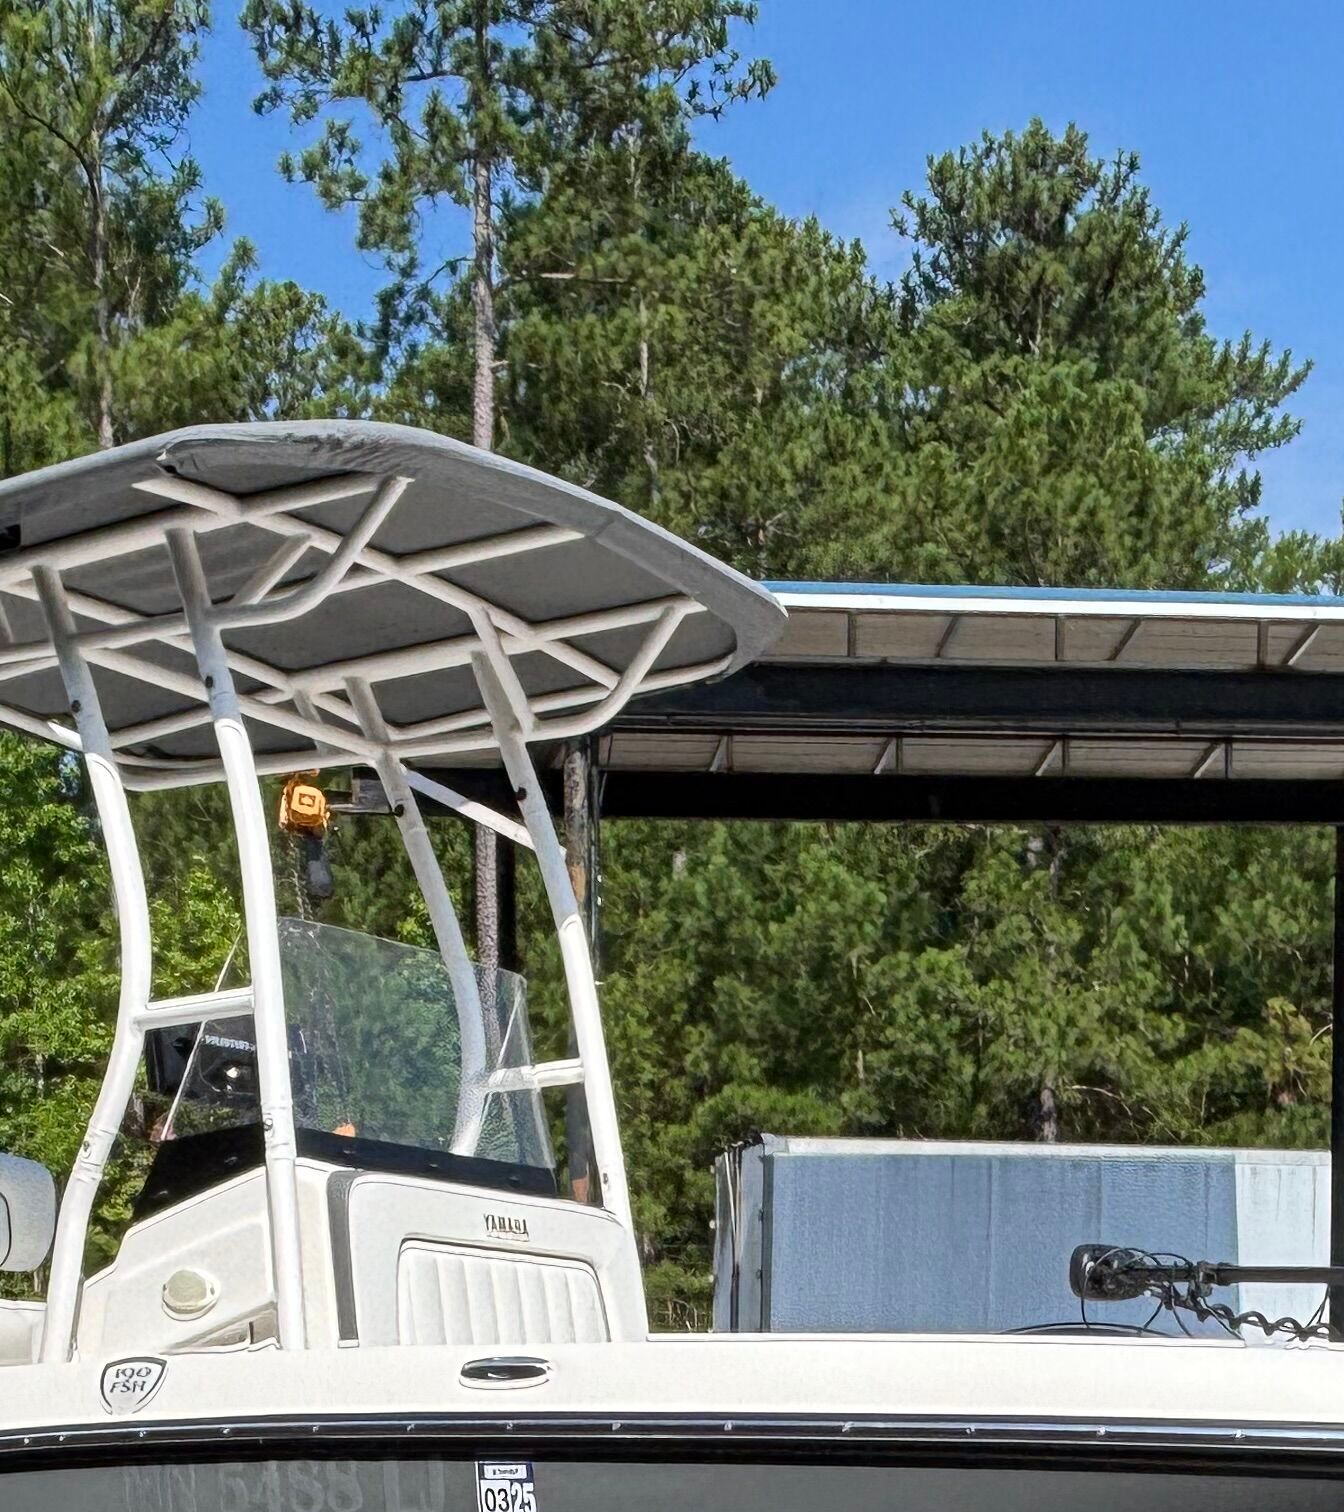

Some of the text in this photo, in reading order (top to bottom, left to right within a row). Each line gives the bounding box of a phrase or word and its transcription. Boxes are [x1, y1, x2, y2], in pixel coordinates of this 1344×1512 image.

[483, 1213, 529, 1236] YAMAHA
[109, 1380, 147, 1393] FSH
[484, 1487, 510, 1512] 03
